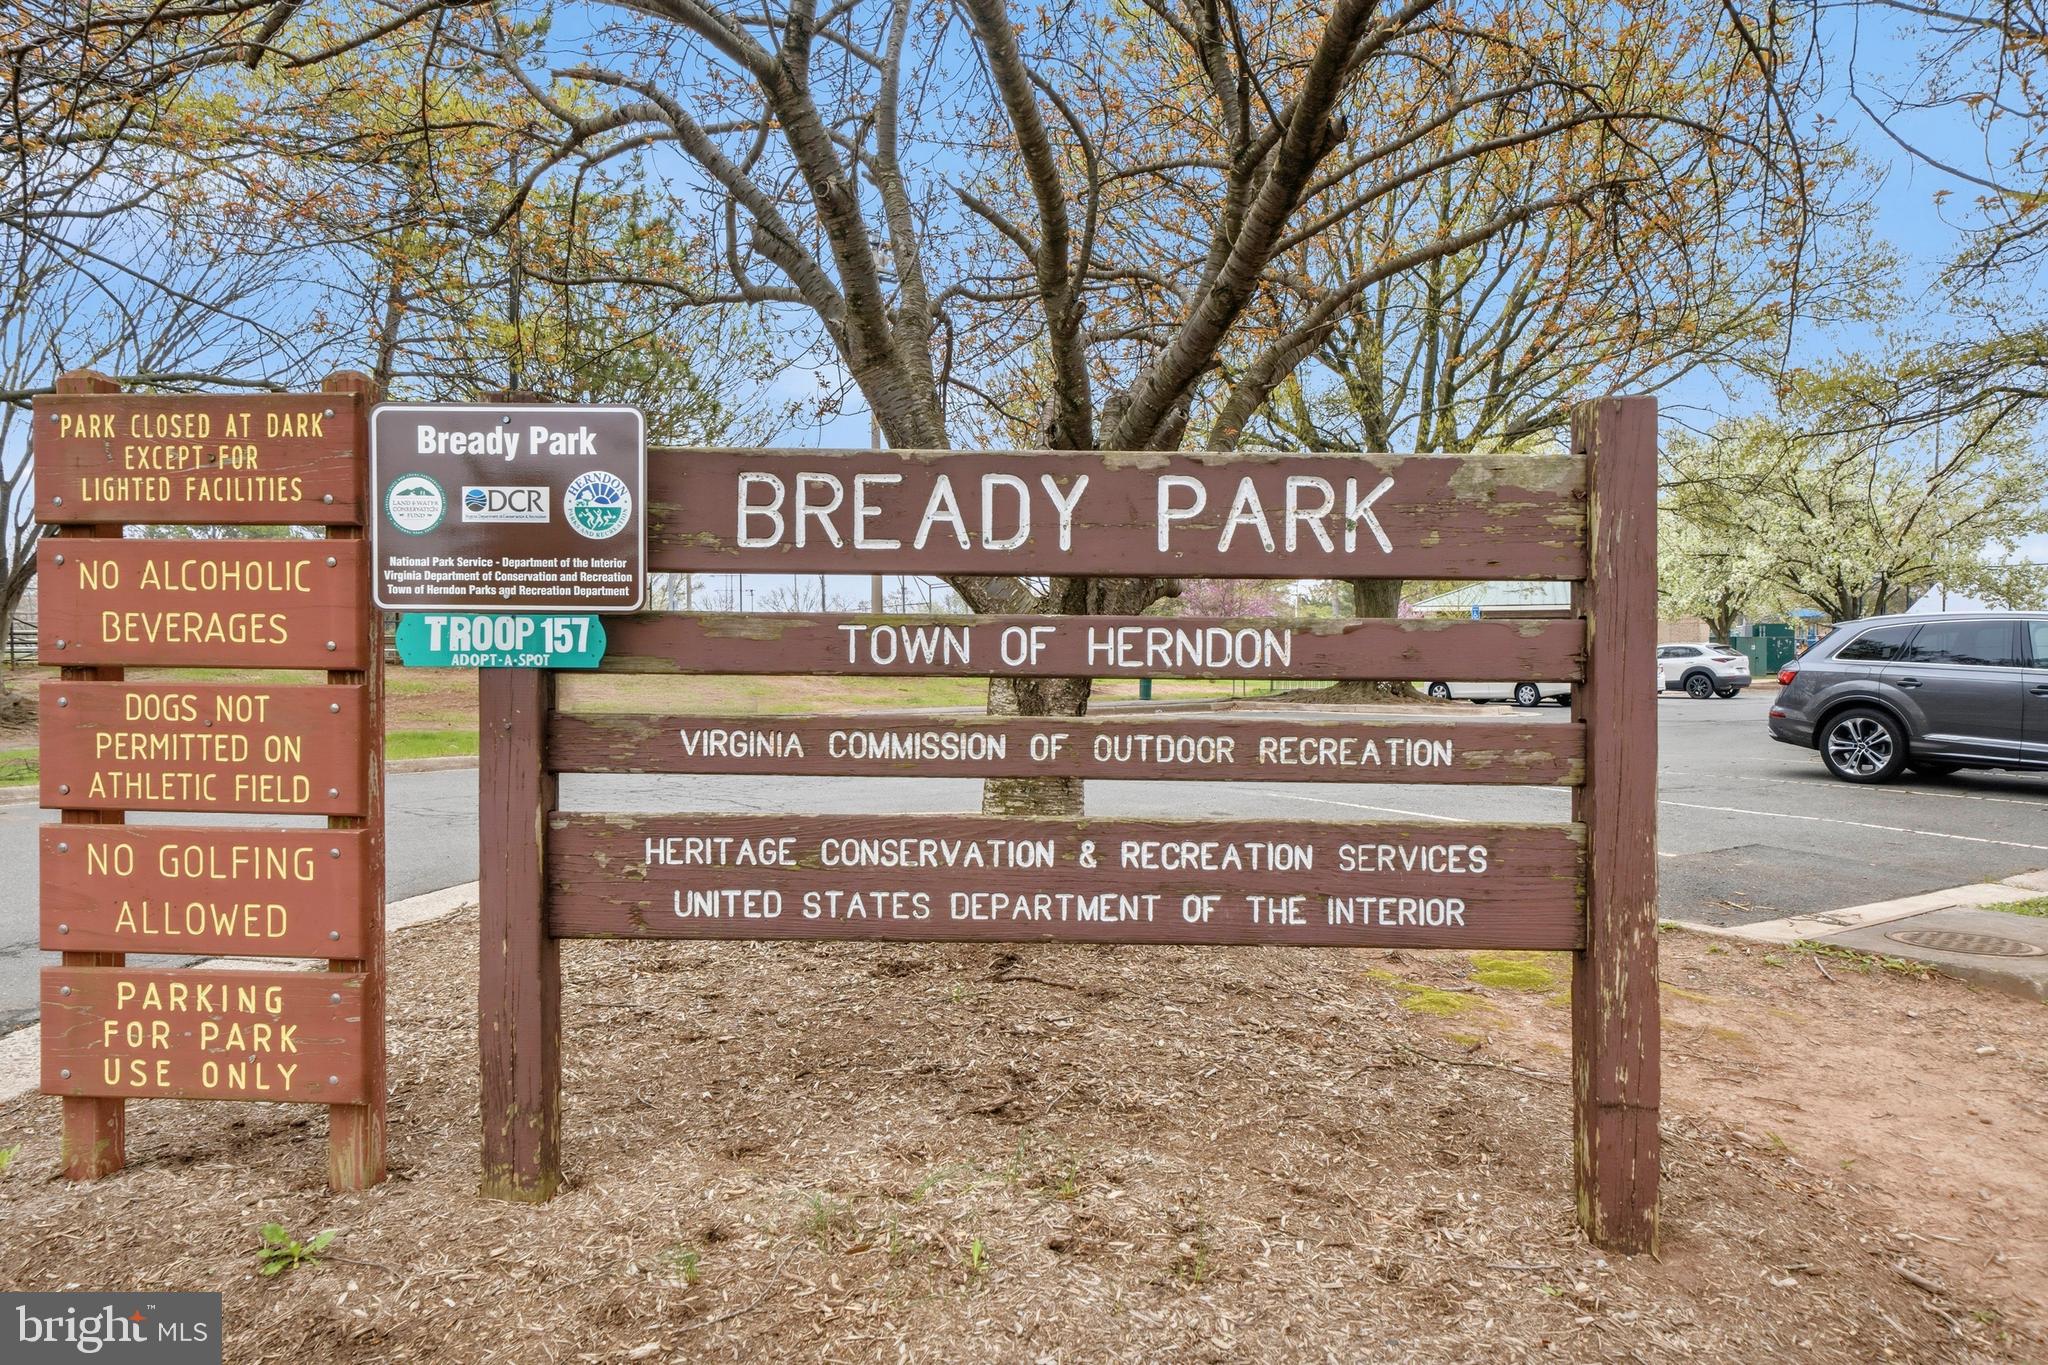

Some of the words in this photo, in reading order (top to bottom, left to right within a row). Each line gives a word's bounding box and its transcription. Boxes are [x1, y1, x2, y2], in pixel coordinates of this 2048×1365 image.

[60, 413, 116, 438] PARK
[131, 413, 210, 438] CLOSED
[225, 413, 251, 438] AT
[267, 412, 324, 438] DARK
[125, 445, 202, 470] EXCEPT
[218, 445, 258, 470] FOR
[417, 425, 520, 461] Bready
[530, 426, 597, 456] Park
[82, 477, 171, 502] LIGHTED
[186, 477, 303, 502] FACILITIES
[488, 489, 544, 512] DCR
[568, 473, 627, 496] HERNDON
[737, 472, 1089, 551] BREADY
[1157, 475, 1395, 553] PARK
[79, 560, 119, 591] NO
[140, 560, 311, 592] ALCOHOLIC
[384, 570, 422, 582] Virginia
[424, 571, 480, 582] Department
[482, 571, 493, 581] of
[495, 571, 557, 581] Conservation
[560, 572, 577, 582] and
[580, 572, 633, 582] Recreation
[389, 556, 429, 567] National
[432, 557, 455, 567] Park
[457, 557, 493, 567] Service
[502, 557, 558, 569] Department
[560, 558, 570, 568] of
[573, 558, 588, 568] the
[591, 558, 627, 568] Interior
[387, 584, 412, 594] Town
[415, 584, 425, 594] of
[427, 585, 466, 595] Herndon
[469, 585, 496, 595] Parks
[519, 586, 571, 596] Recreation
[574, 586, 630, 597] Department
[102, 611, 288, 644] BEVERAGES
[425, 615, 535, 651] TROOP
[541, 617, 590, 653] 157
[838, 625, 970, 665] TOWN
[1001, 626, 1056, 666] OF
[1088, 627, 1291, 668] HERNDON
[125, 693, 198, 722] DOGS
[216, 695, 270, 723] NOT
[96, 732, 250, 763] PERMITTED
[264, 735, 301, 763] ON
[680, 729, 804, 758] VIRGINIA
[828, 730, 1006, 760] COMMISSION
[1029, 733, 1069, 761] OF
[1093, 734, 1235, 764] OUTDOOR
[1259, 736, 1453, 767] RECREATION
[88, 772, 217, 801] ATHLETIC
[235, 774, 310, 804] FIELD
[88, 843, 134, 876] NO
[159, 844, 314, 881] GOLFING
[644, 837, 797, 867] HERITAGE
[820, 838, 1055, 869] CONSERVATION
[1078, 839, 1097, 869] &
[1121, 840, 1313, 872] RECREATION
[1339, 843, 1488, 874] SERVICES
[115, 901, 287, 938] ALLOWED
[674, 889, 782, 919] UNITED
[802, 891, 930, 920] STATES
[950, 891, 1161, 922] DEPARTMENT
[1182, 895, 1221, 924] OF
[1245, 895, 1306, 926] THE
[1327, 897, 1466, 927] INTERIOR
[117, 981, 282, 1014] PARKING
[104, 1020, 170, 1050] FOR
[201, 1021, 297, 1053] PARK
[104, 1058, 170, 1087] USE
[201, 1061, 297, 1091] ONLY
